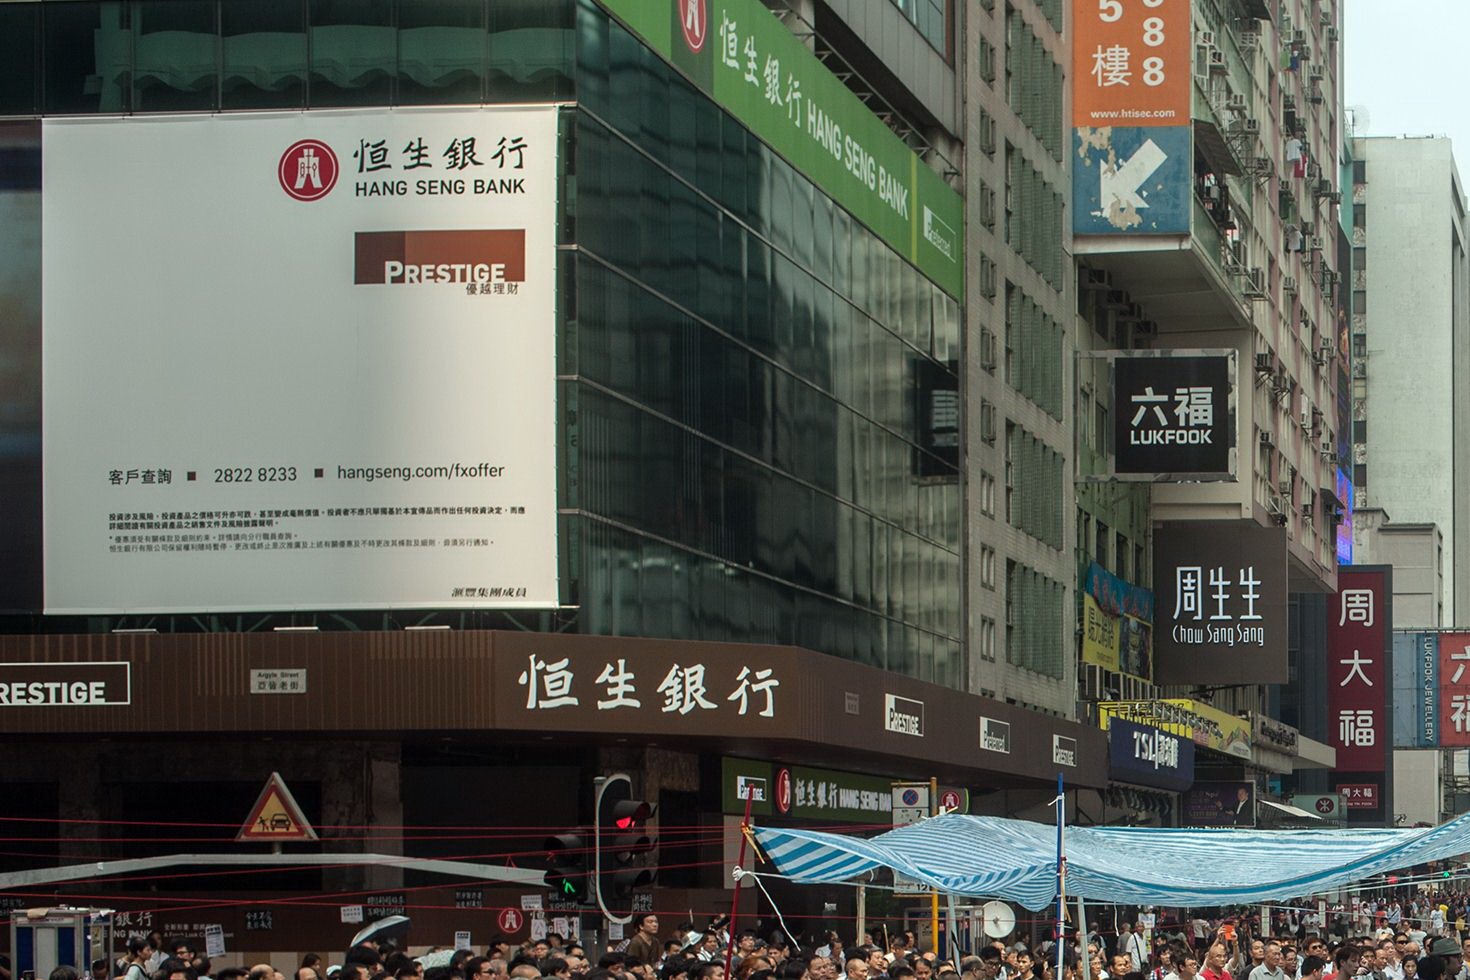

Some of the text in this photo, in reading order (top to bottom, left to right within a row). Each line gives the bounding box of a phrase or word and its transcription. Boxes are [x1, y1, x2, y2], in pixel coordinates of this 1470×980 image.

[1143, 0, 1165, 86] 88
[720, 9, 802, 128] 恒生銀行
[1090, 109, 1176, 118] www.htisec.com
[353, 136, 528, 173] 恒生銀行
[807, 98, 908, 221] HANG SENG BANK
[355, 178, 526, 197] HANG SENG BANK
[466, 283, 519, 295] 優越理財
[1131, 387, 1214, 427] 六福
[1131, 430, 1213, 445] LUKFOOK
[215, 468, 253, 482] 2822
[258, 467, 297, 482] 8233
[337, 463, 505, 482] hangseng.com/fxoffer
[1172, 566, 1264, 620] 周生生
[1172, 624, 1264, 646] Chow Sang Sang
[257, 671, 300, 680] Argyle Street
[518, 654, 780, 718] 恒生銀行
[1339, 589, 1375, 748] 周大福
[1424, 636, 1433, 742] LUKFOOK JEWELLERY
